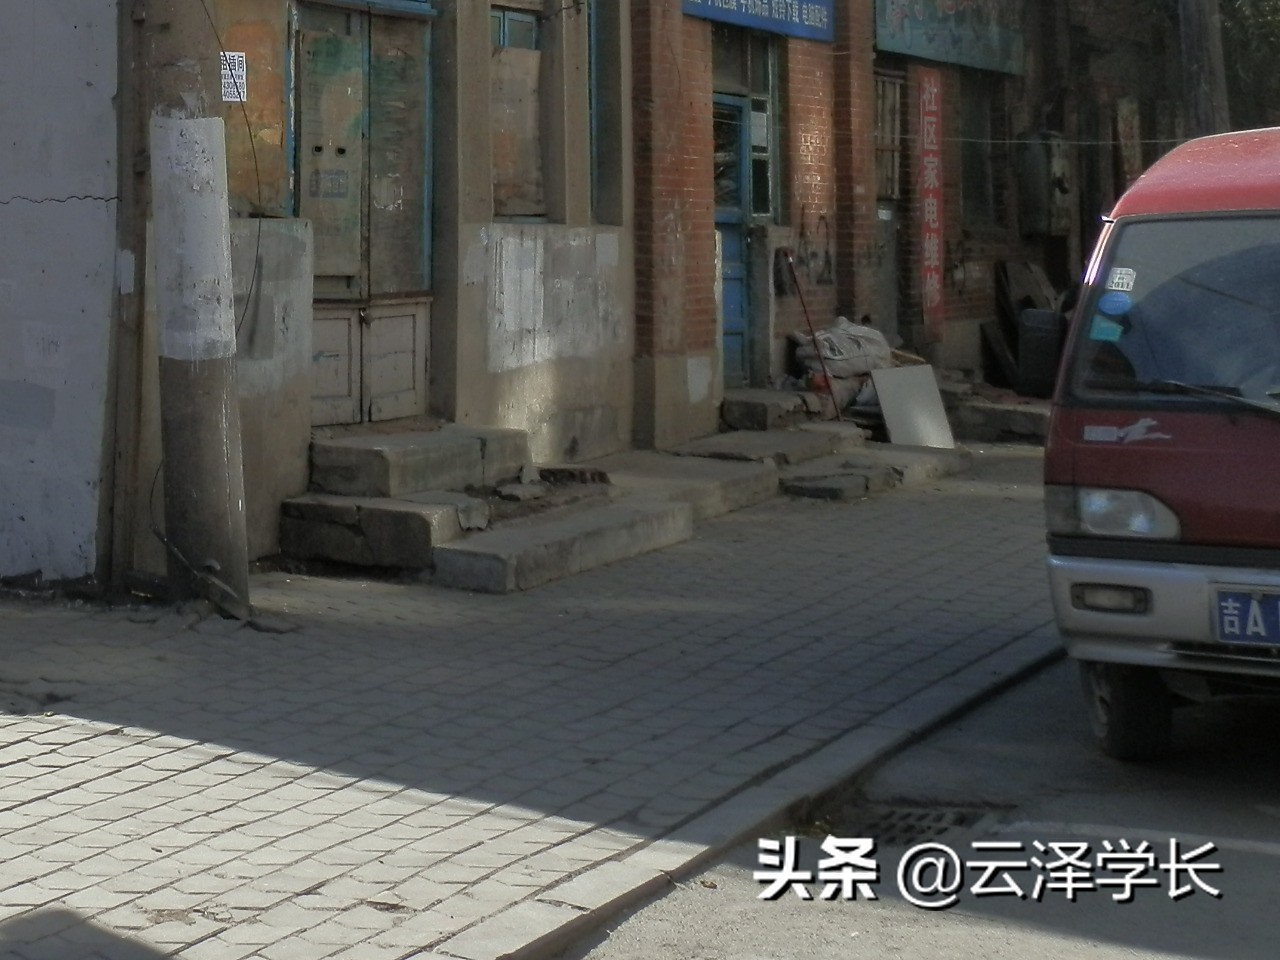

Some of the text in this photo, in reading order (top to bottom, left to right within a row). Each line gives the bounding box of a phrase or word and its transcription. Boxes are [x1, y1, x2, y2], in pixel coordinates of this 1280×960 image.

[922, 76, 941, 307] 社区家电维修
[1220, 598, 1280, 637] 吉A
